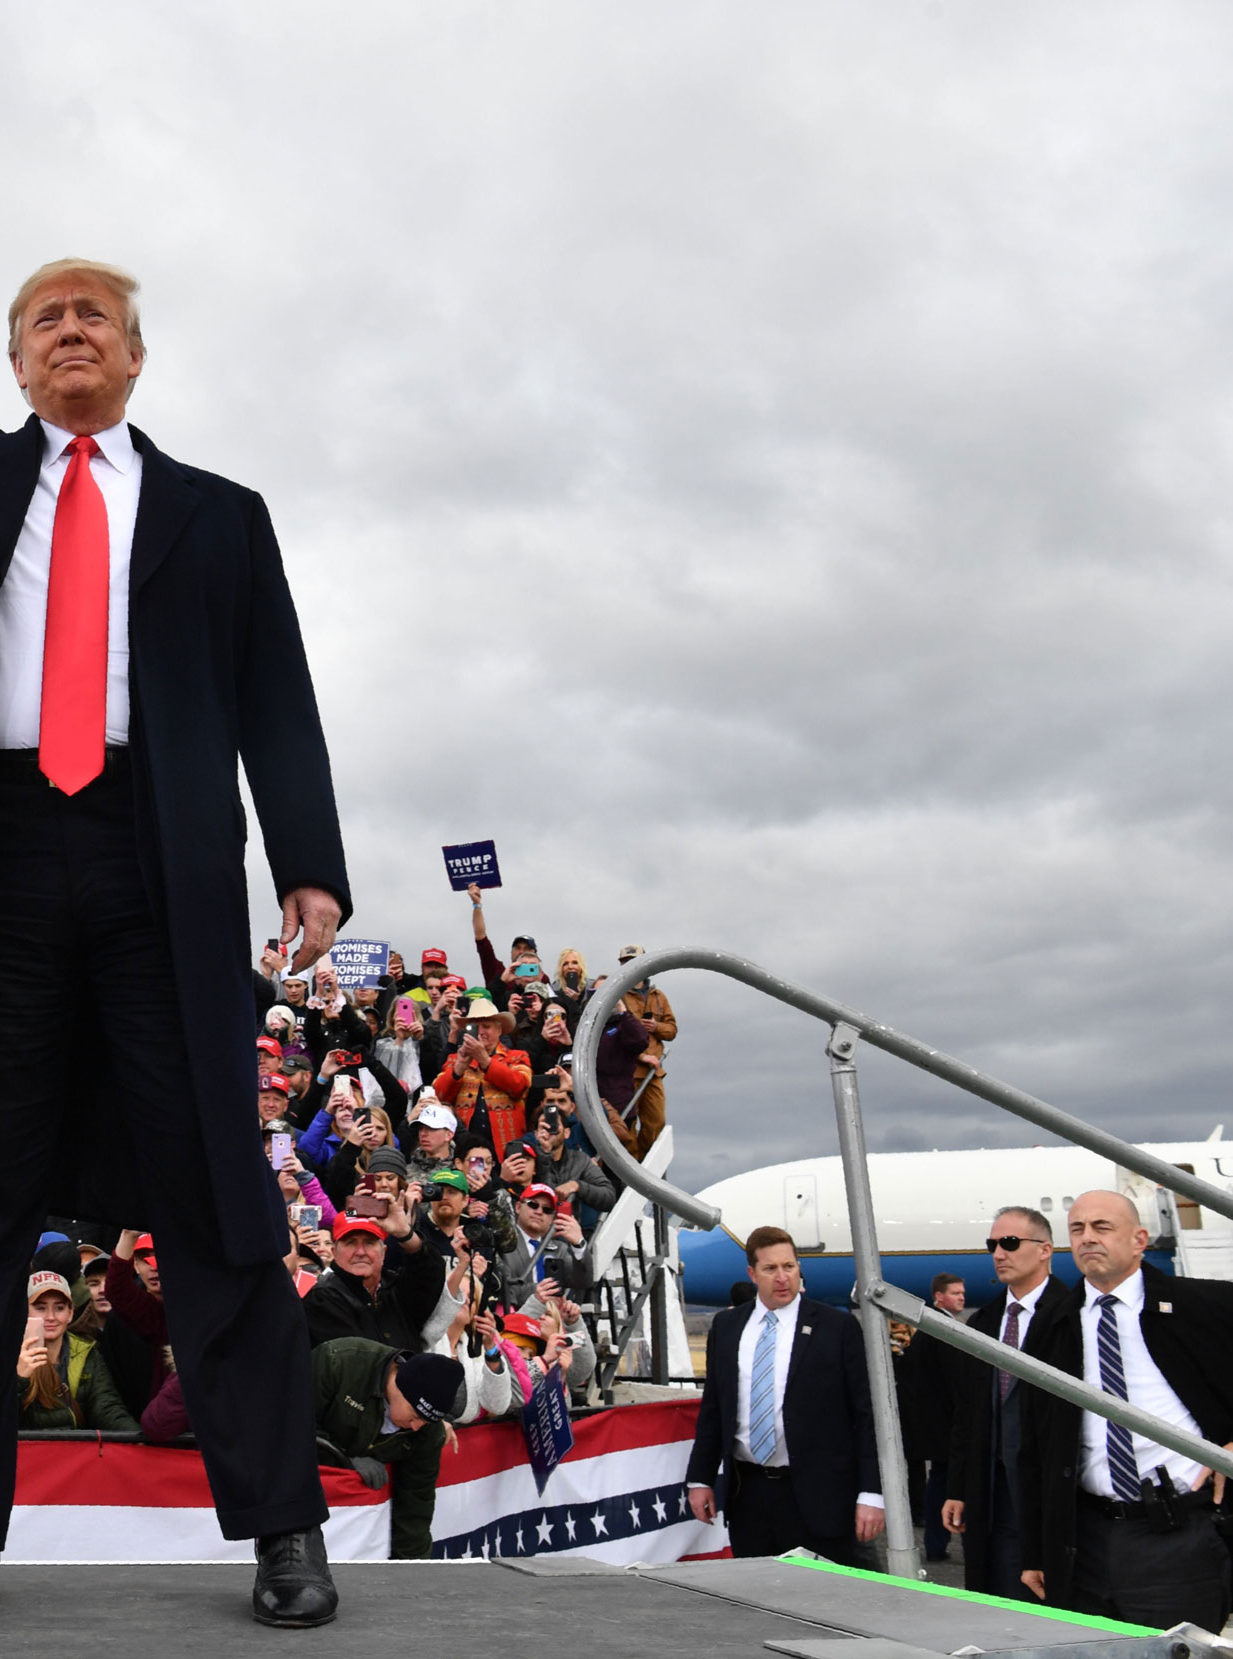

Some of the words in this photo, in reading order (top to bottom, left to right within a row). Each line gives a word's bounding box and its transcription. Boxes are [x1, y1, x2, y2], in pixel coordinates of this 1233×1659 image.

[448, 854, 492, 868] TRUMP
[453, 864, 489, 874] PENCE
[336, 953, 370, 963] MADE
[332, 965, 381, 976] ROMISES
[337, 975, 366, 985] KEPT
[32, 1273, 63, 1287] NFR
[344, 1395, 365, 1412] Travis
[549, 1387, 563, 1431] GREAT
